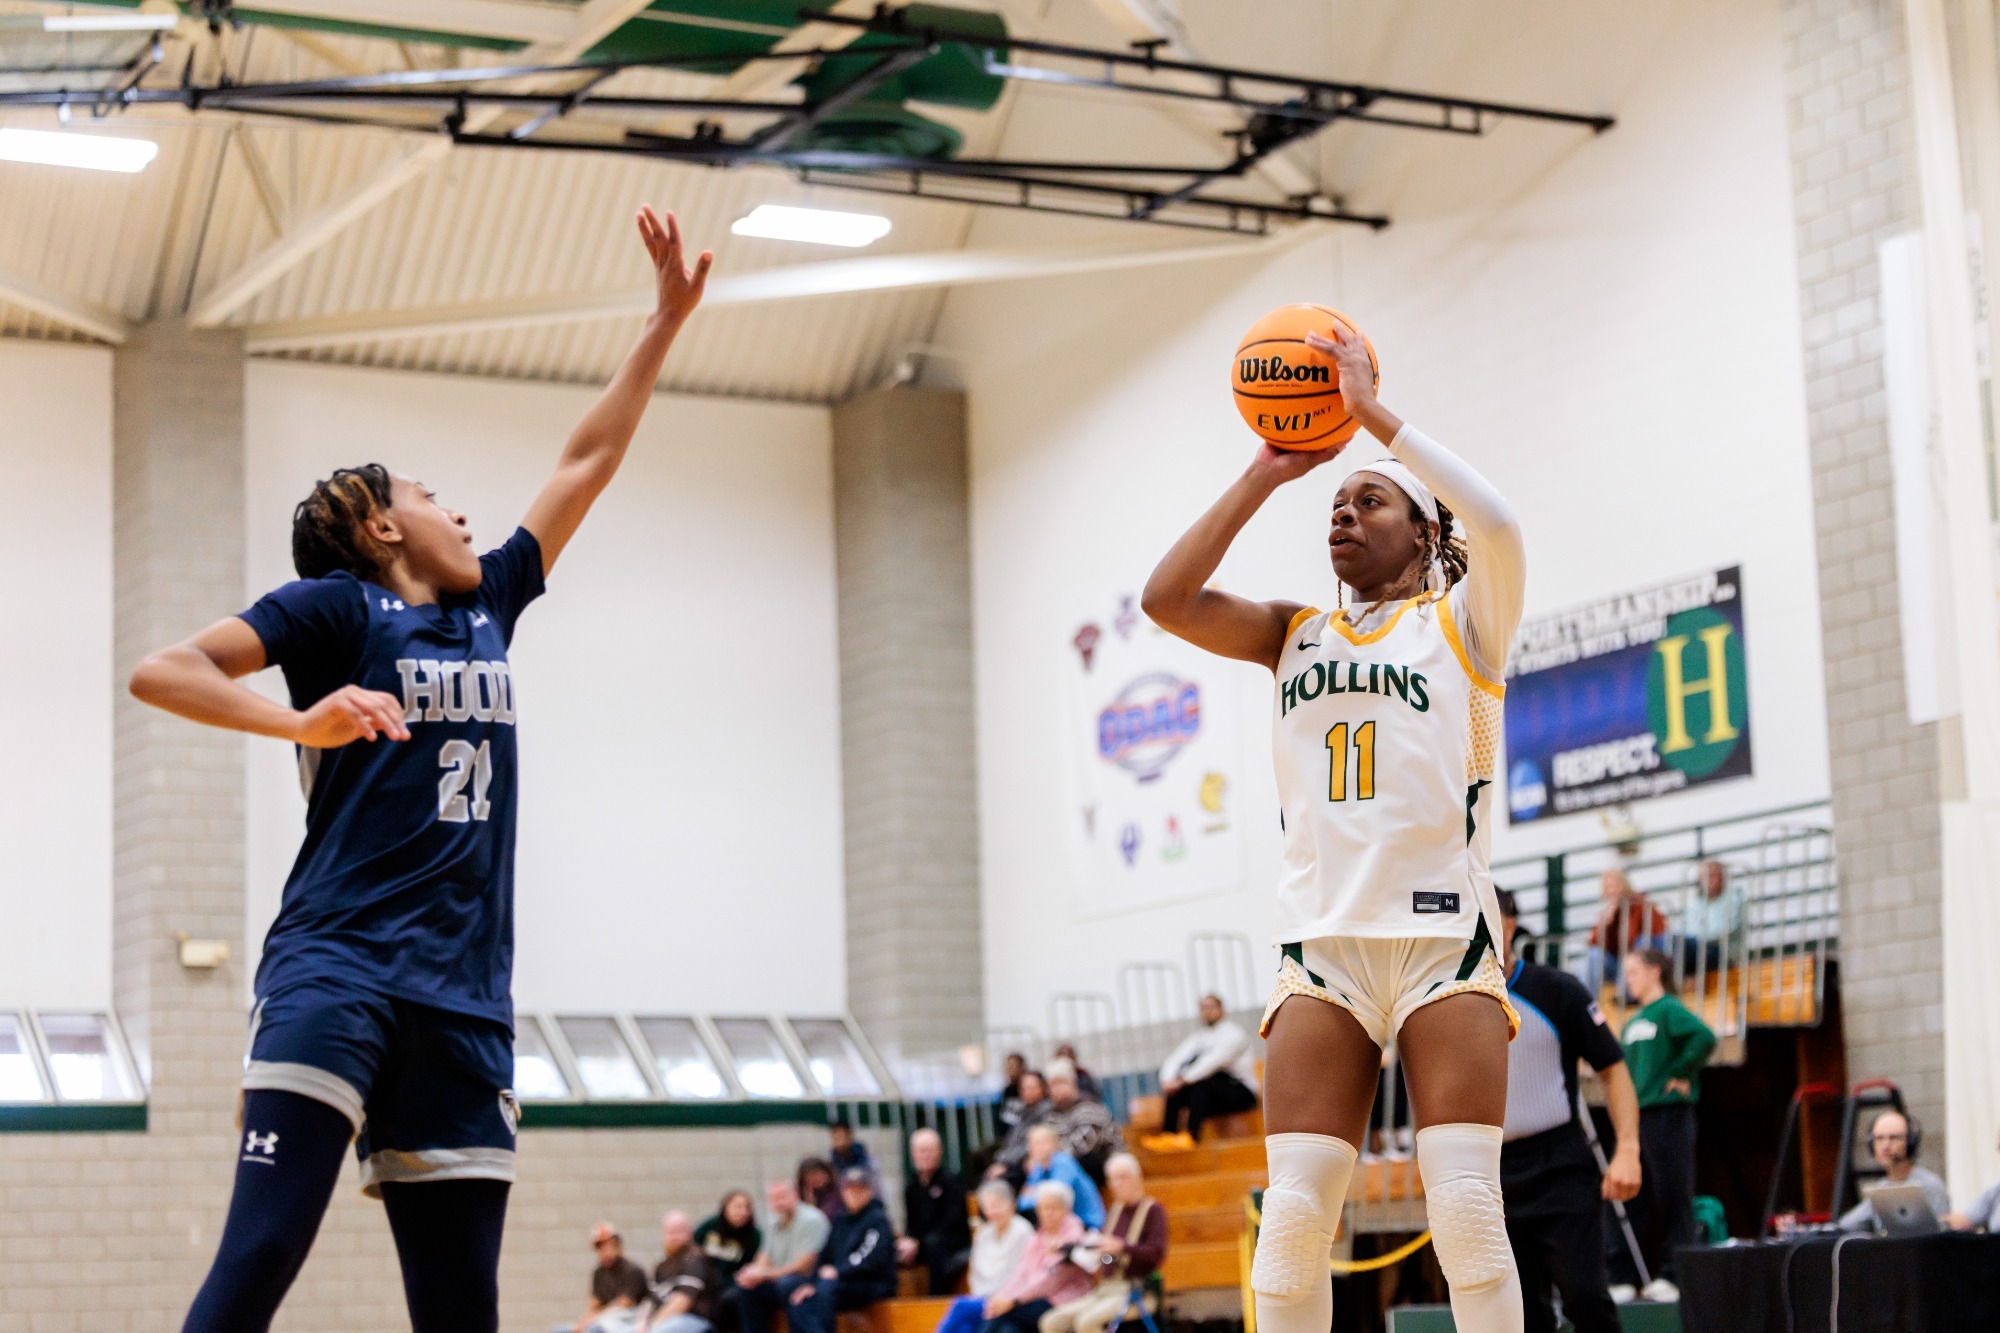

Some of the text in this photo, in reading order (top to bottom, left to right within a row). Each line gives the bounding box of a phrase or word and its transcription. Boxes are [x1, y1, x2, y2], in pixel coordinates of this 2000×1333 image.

[1240, 356, 1330, 384] Wilson
[396, 659, 516, 726] HOOD
[1282, 660, 1430, 720] HOLLINS
[1656, 623, 1739, 755] H
[438, 739, 492, 822] 21
[1325, 720, 1376, 802] 11
[1445, 898, 1454, 908] M
